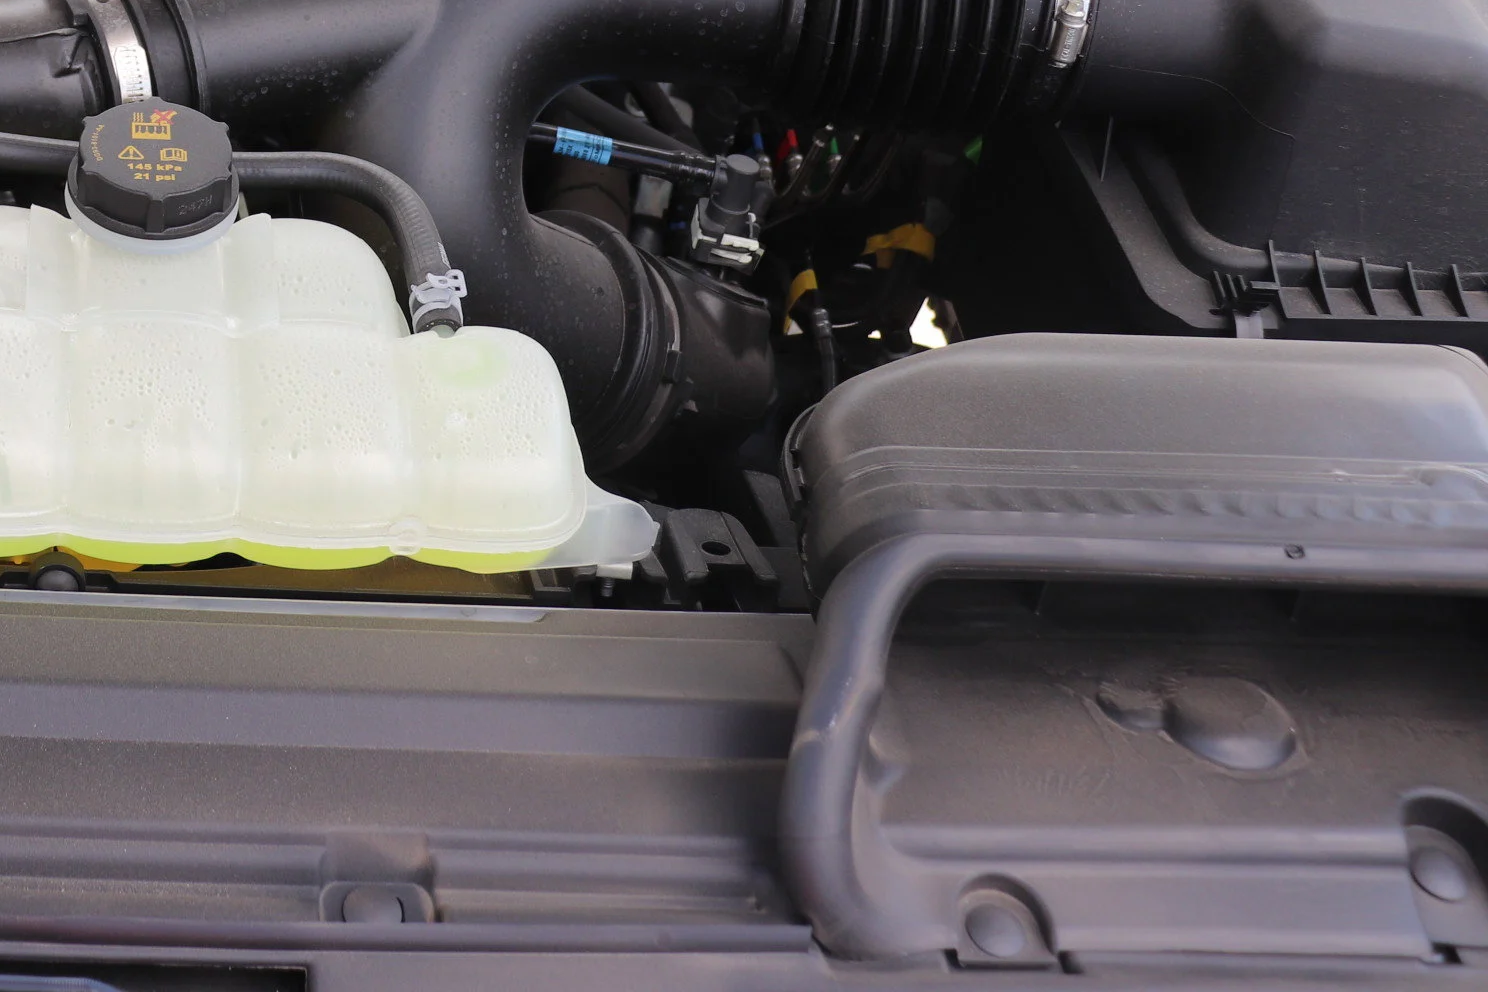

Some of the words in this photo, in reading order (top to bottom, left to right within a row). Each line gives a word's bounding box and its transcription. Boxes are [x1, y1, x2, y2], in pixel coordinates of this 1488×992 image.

[127, 162, 152, 171] 145
[156, 163, 183, 172] kPa
[133, 173, 151, 181] 21
[155, 173, 176, 182] psi
